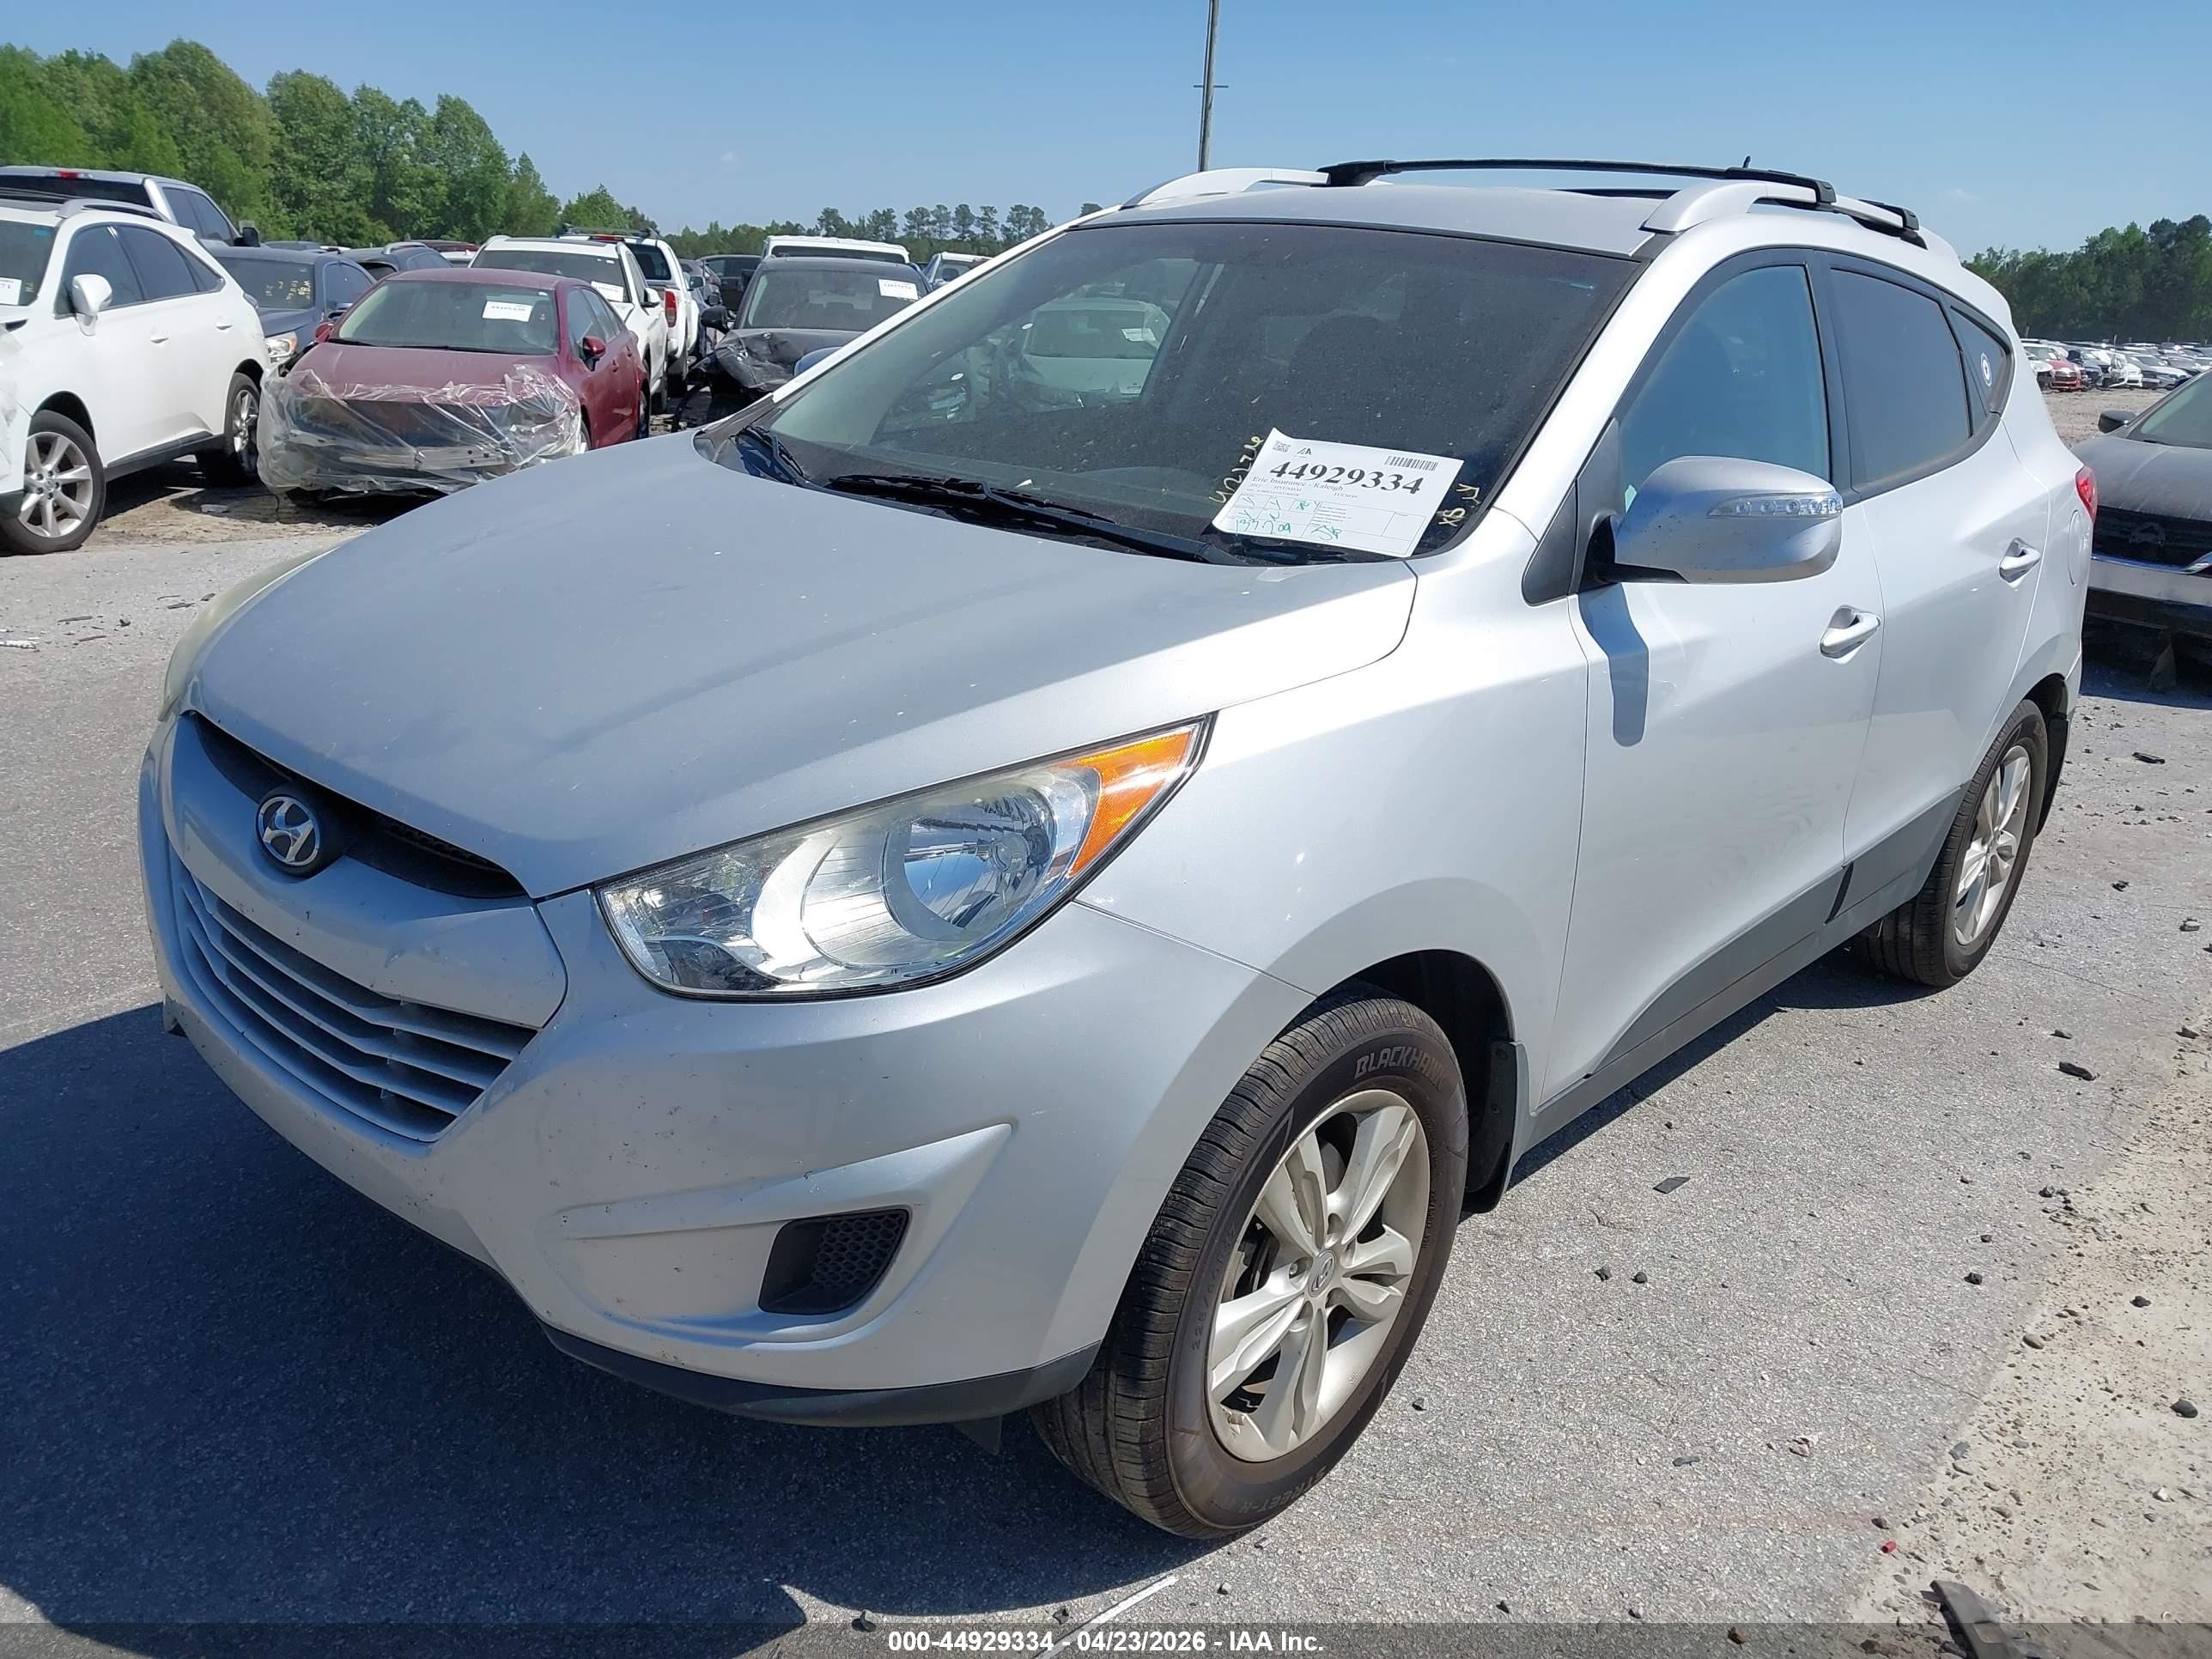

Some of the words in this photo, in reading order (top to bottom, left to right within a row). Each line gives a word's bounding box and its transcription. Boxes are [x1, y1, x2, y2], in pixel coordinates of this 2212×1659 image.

[1269, 461, 1424, 495] 44929334
[1270, 477, 1307, 487] Insurance
[1314, 483, 1345, 492] Raleigh
